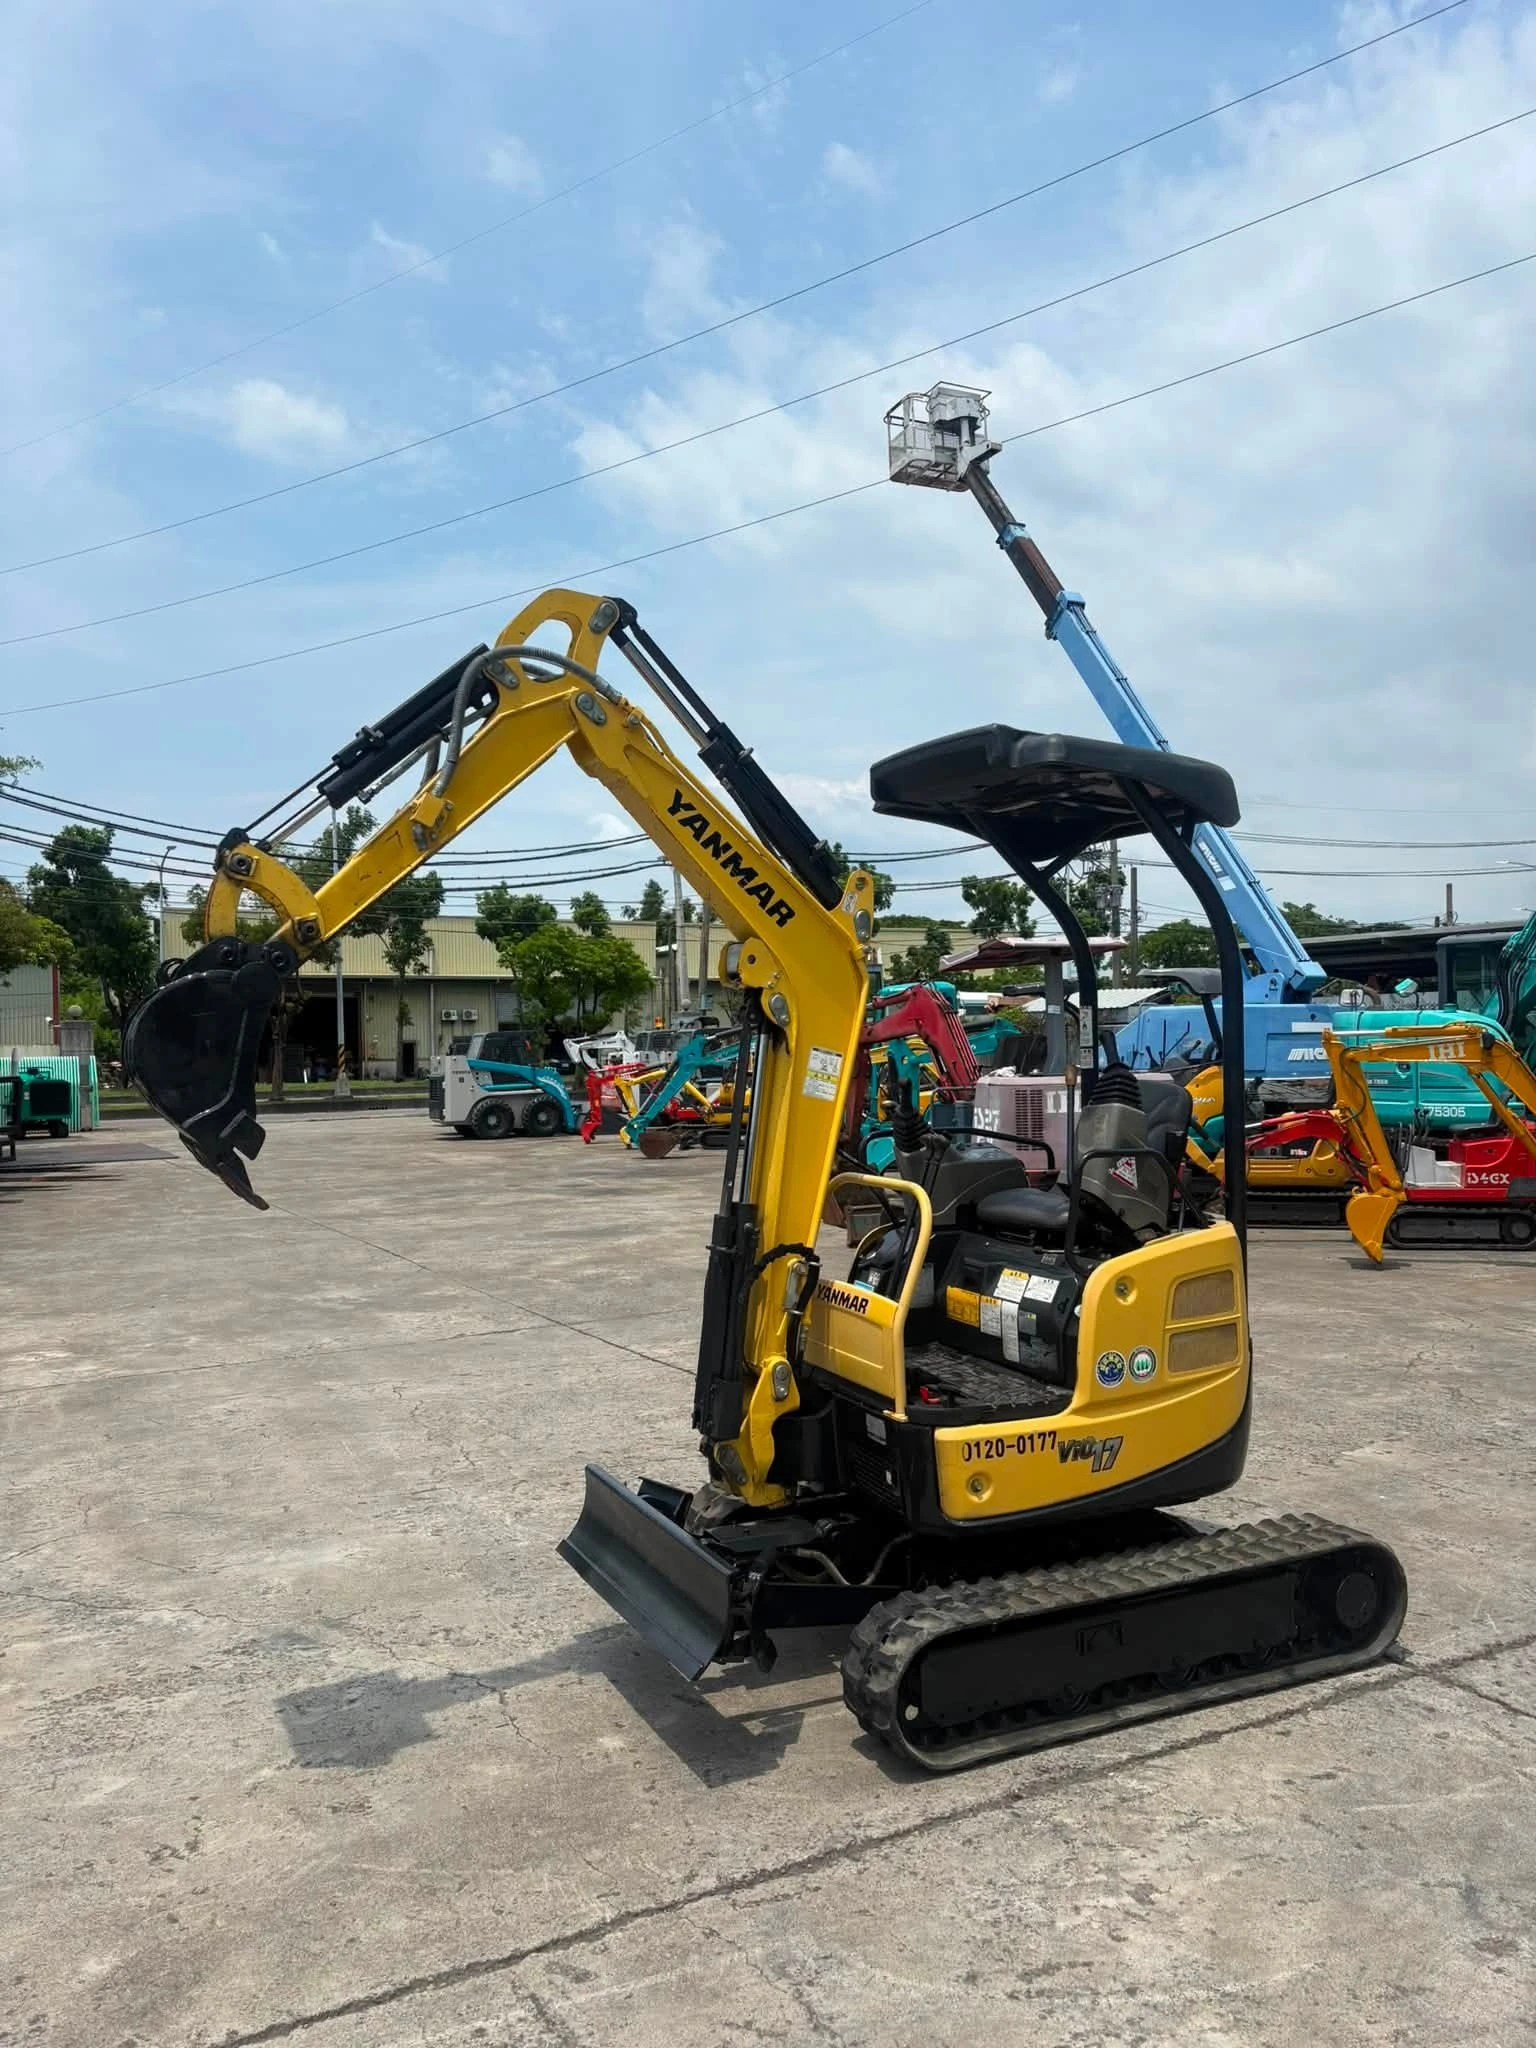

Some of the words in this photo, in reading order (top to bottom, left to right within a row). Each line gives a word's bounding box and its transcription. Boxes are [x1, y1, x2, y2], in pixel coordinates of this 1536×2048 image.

[667, 789, 796, 928] YANMAR
[1428, 1042, 1466, 1061] IHI
[816, 1284, 870, 1315] YANMAR
[961, 1430, 1057, 1462] 0120-0177
